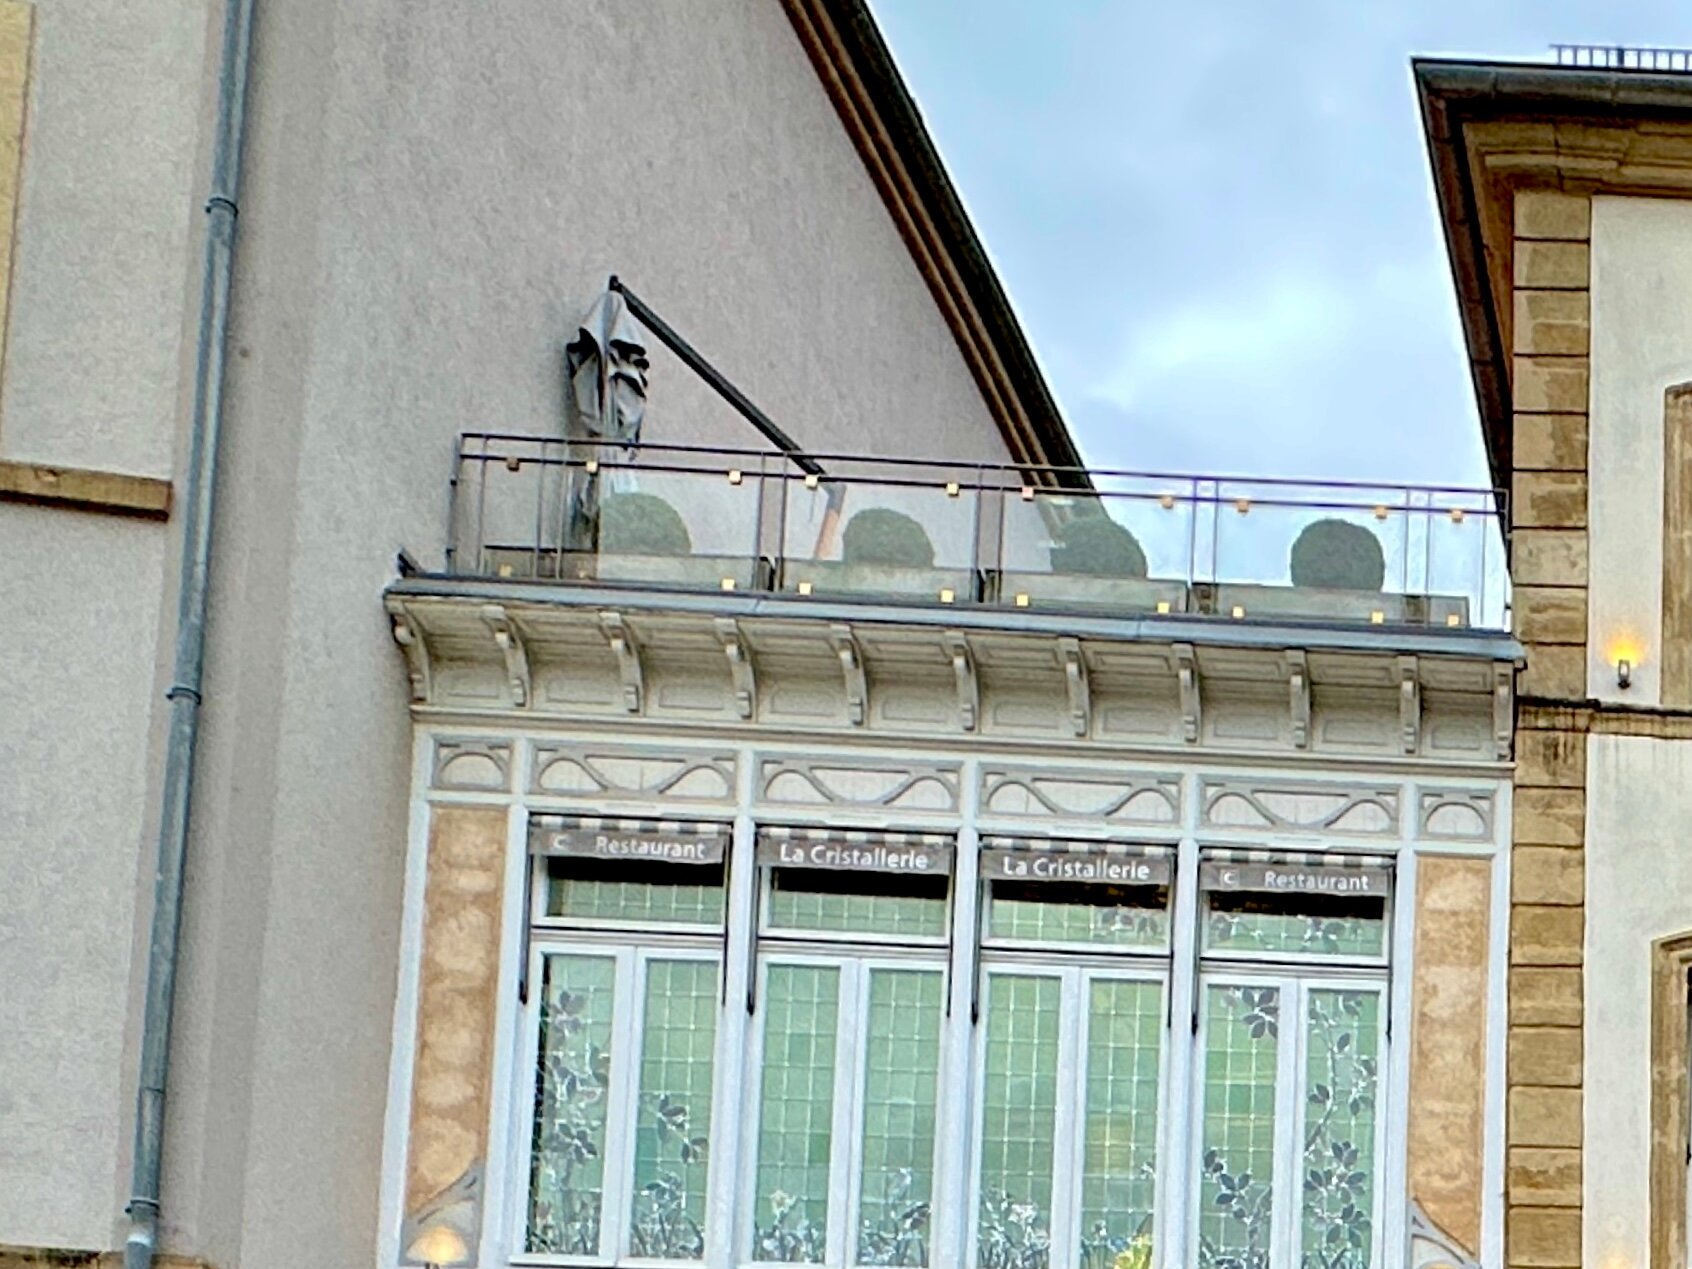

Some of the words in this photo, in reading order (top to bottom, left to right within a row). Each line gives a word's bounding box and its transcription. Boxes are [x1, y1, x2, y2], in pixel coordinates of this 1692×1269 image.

[595, 836, 705, 858] Restaurant
[780, 843, 804, 863] La
[811, 845, 928, 869] Cristallerie
[1003, 856, 1028, 876] La
[1033, 857, 1150, 880] Cristallerie
[1264, 871, 1369, 891] Restaurant
